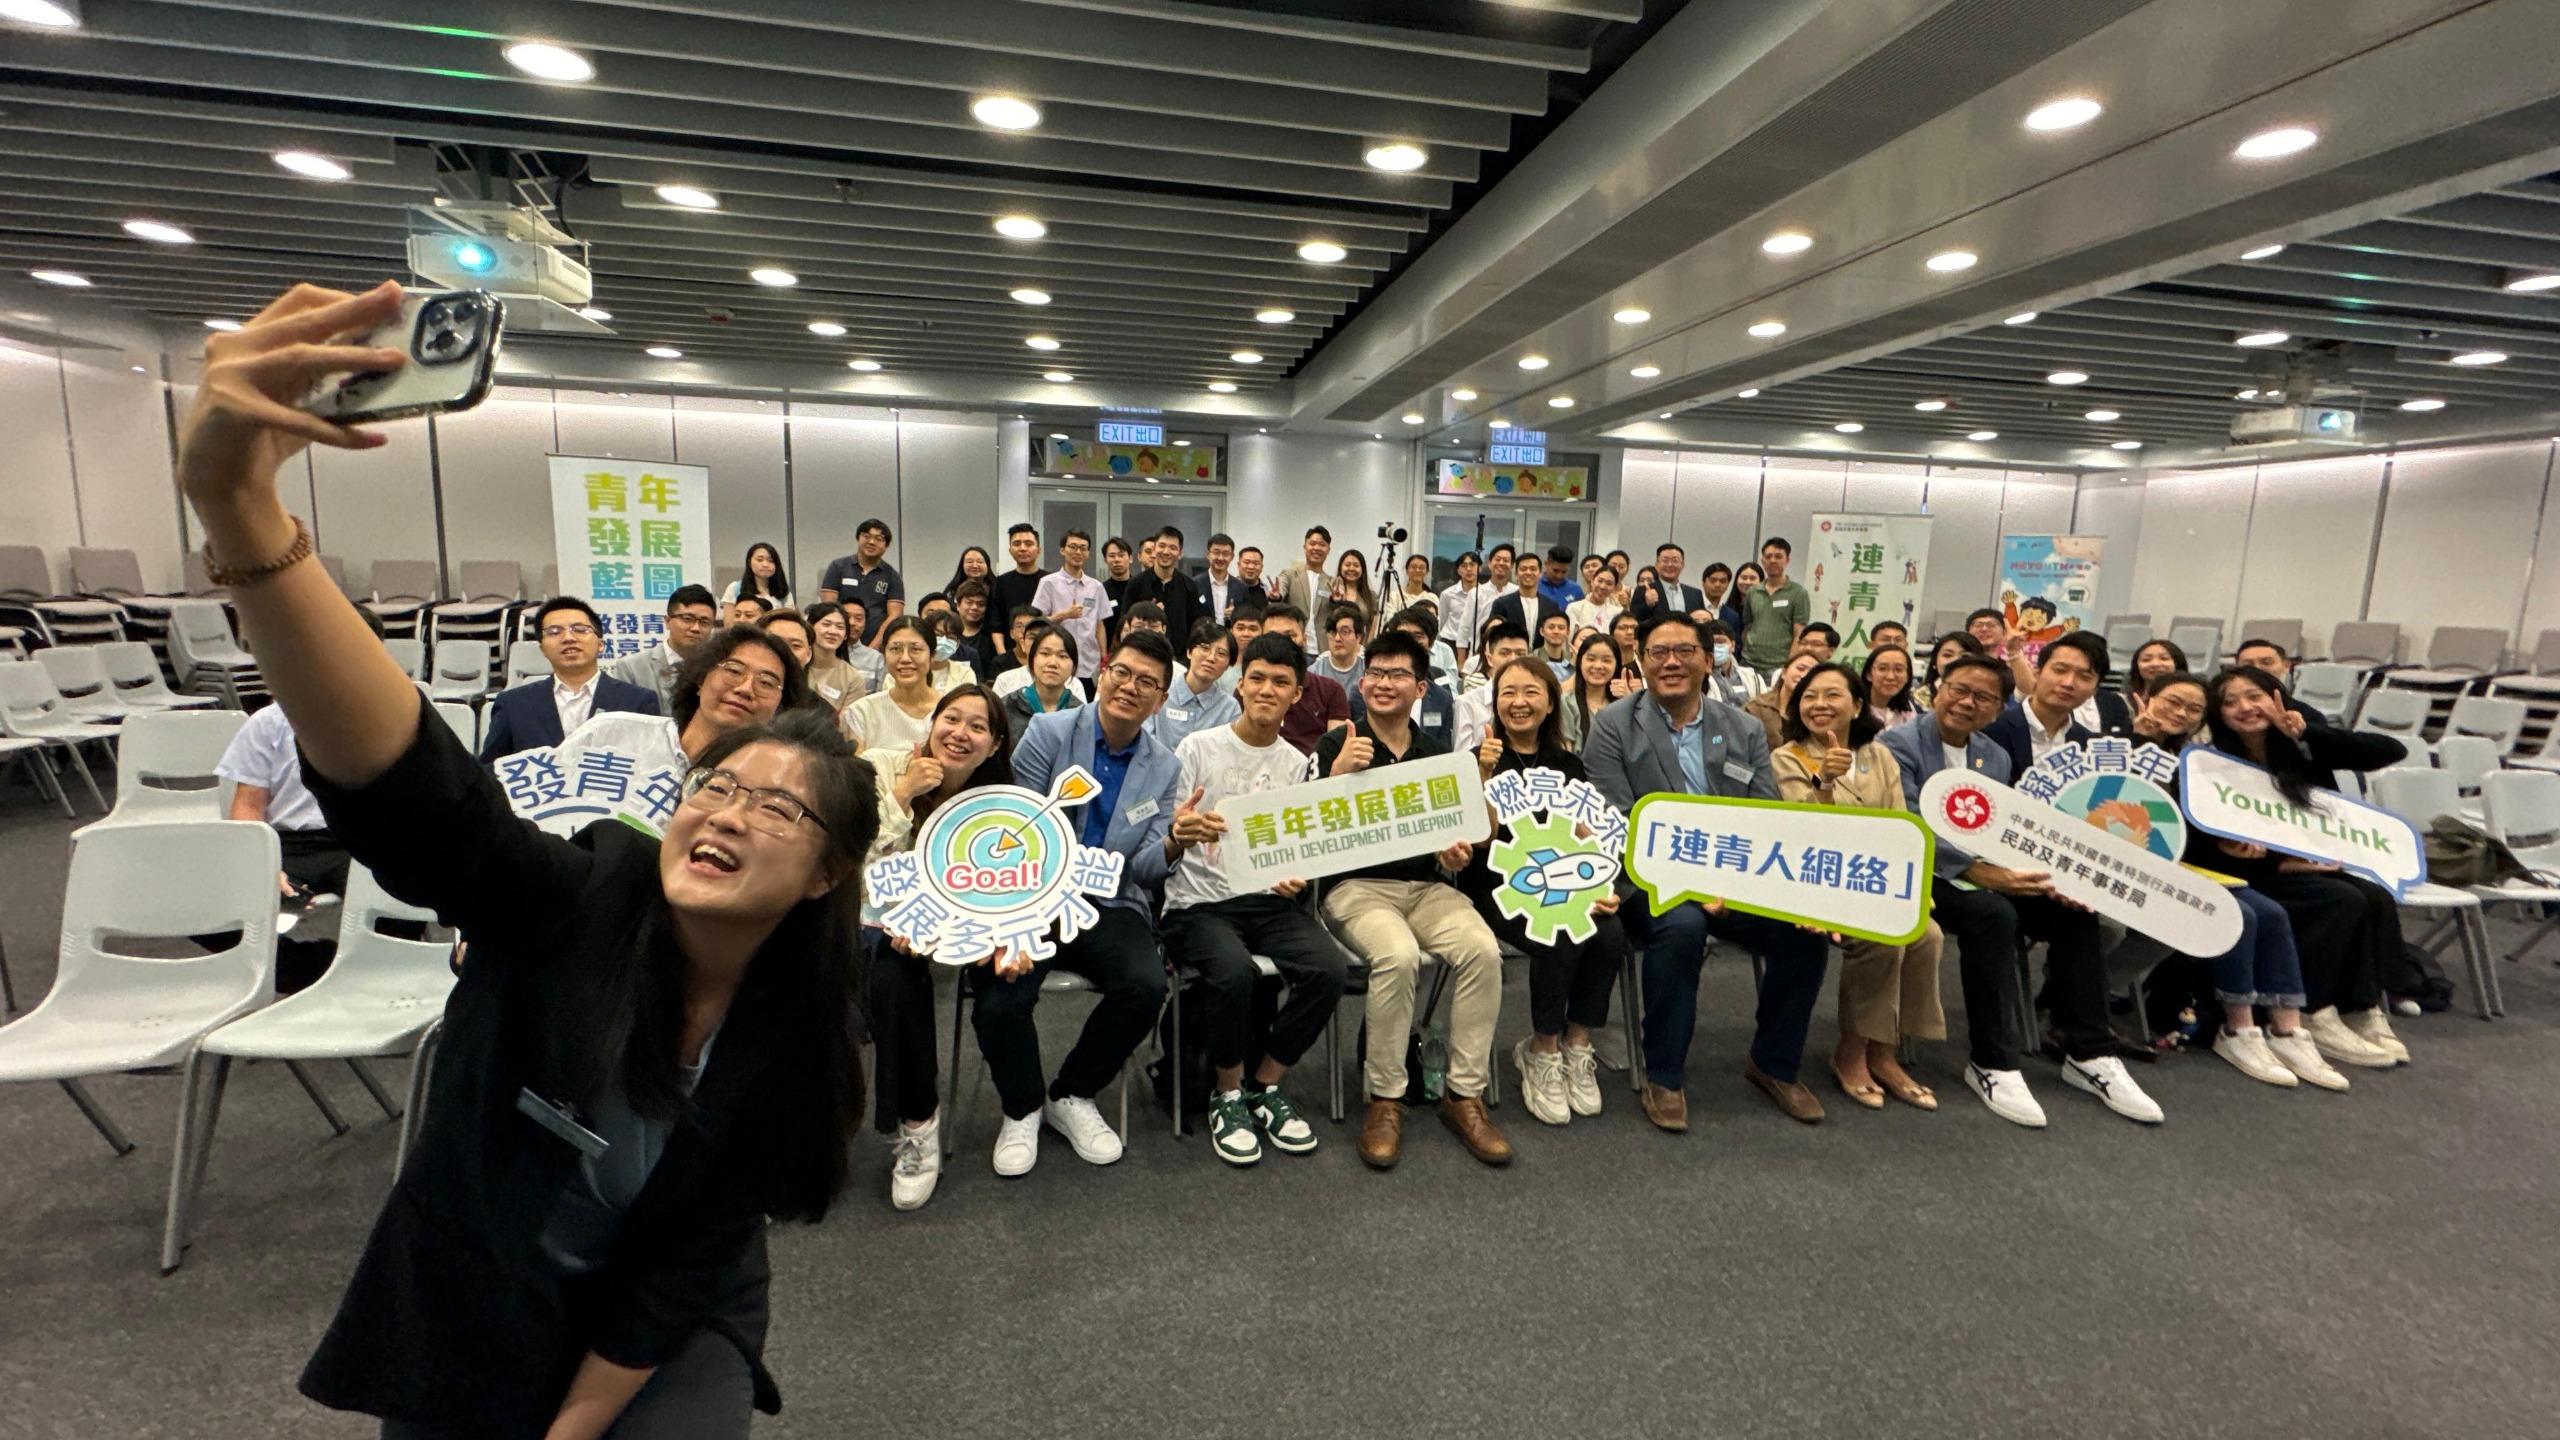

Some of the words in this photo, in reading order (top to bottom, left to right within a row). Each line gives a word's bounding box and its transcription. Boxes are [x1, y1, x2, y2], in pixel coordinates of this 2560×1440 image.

[1102, 424, 1134, 442] EXIT
[1136, 426, 1160, 444] 出口
[1493, 446, 1520, 463] EXIT
[1522, 447, 1543, 463] 出口
[584, 472, 682, 514] 青年
[586, 517, 683, 558] 發展
[590, 561, 683, 602] 藍圖
[1242, 773, 1464, 850] 青年發展藍圖
[1248, 847, 1296, 871] YOUTH
[1300, 827, 1392, 860] DEVELOPMENT
[1398, 809, 1464, 839] BLUEPRINT
[2213, 781, 2309, 829] Youth
[2318, 814, 2393, 854] Link
[945, 863, 1042, 891] Goal!
[1646, 821, 1914, 901] 「連青人網絡」
[2000, 828, 2149, 909] 民政及青年事務局
[2009, 813, 2217, 917] 中華人民共和國香港特別行政區政府
[870, 850, 1120, 961] 發展多元才能
